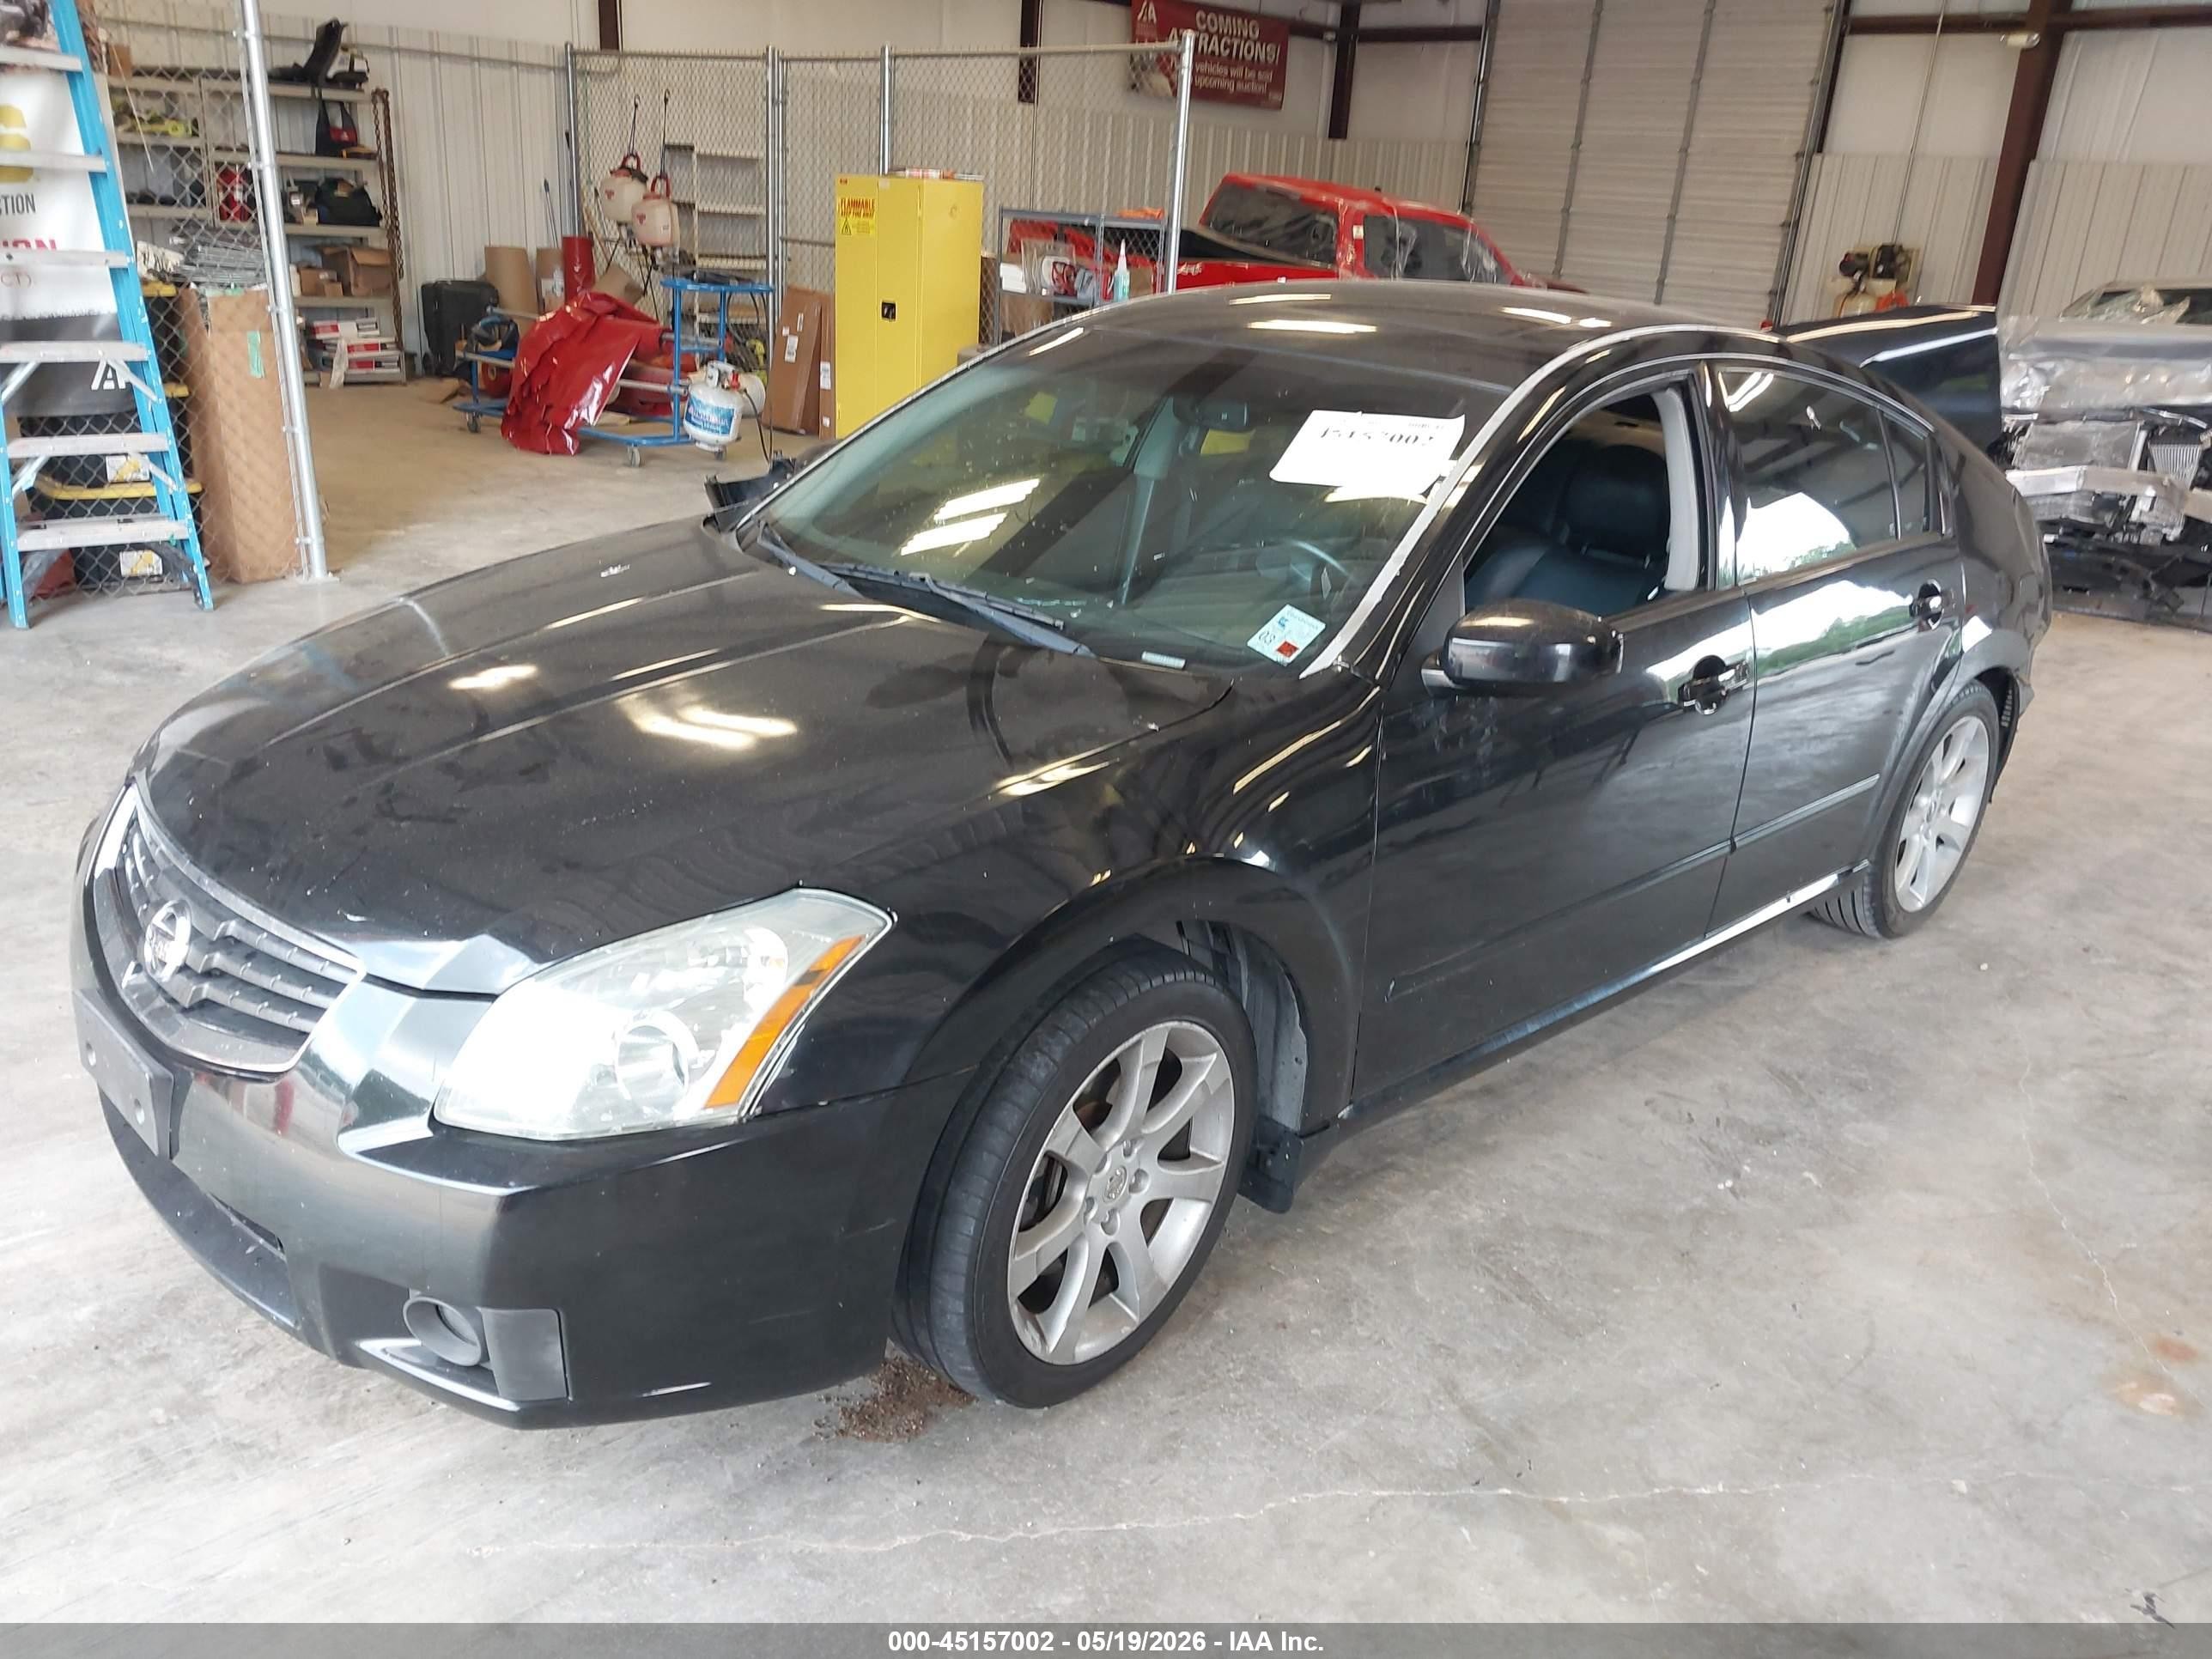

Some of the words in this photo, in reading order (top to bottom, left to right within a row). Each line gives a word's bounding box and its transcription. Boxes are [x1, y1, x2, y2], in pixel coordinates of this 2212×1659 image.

[1195, 9, 1260, 40] COMING
[1168, 27, 1281, 65] ARACTIONS!
[1194, 75, 1235, 94] upcoming
[0, 193, 36, 216] TION
[841, 198, 875, 210] FLAMMABLE
